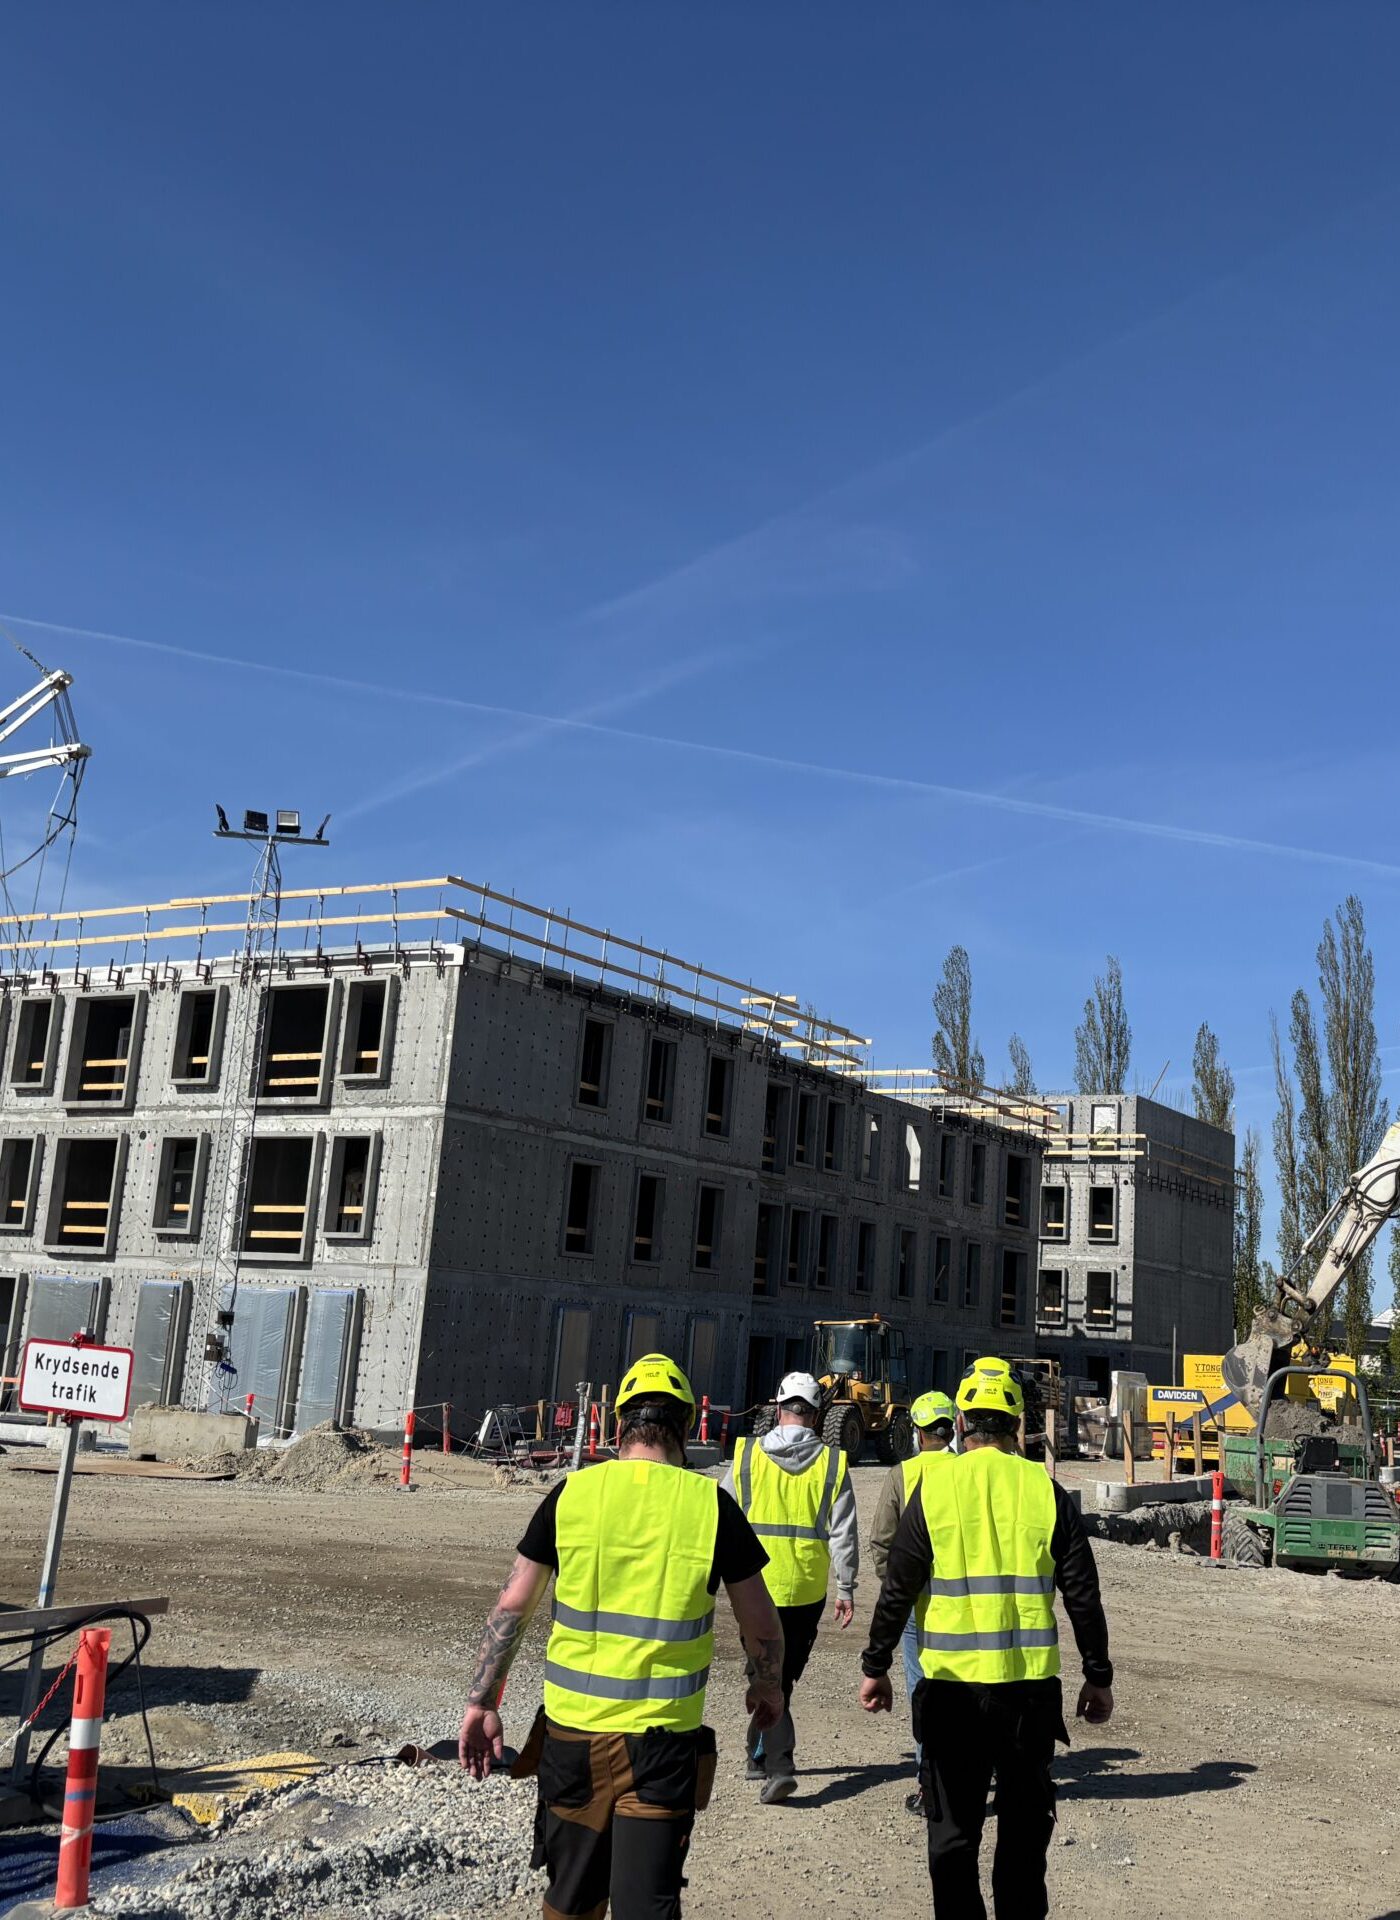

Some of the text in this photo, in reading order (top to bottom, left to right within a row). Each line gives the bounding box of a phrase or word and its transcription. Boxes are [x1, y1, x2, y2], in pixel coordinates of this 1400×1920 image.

[35, 1352, 119, 1379] Krydsende
[1195, 1363, 1221, 1372] YTONG
[52, 1382, 97, 1403] trafik
[1157, 1390, 1198, 1400] DAVIDSEN
[1327, 1543, 1358, 1551] TEREX
